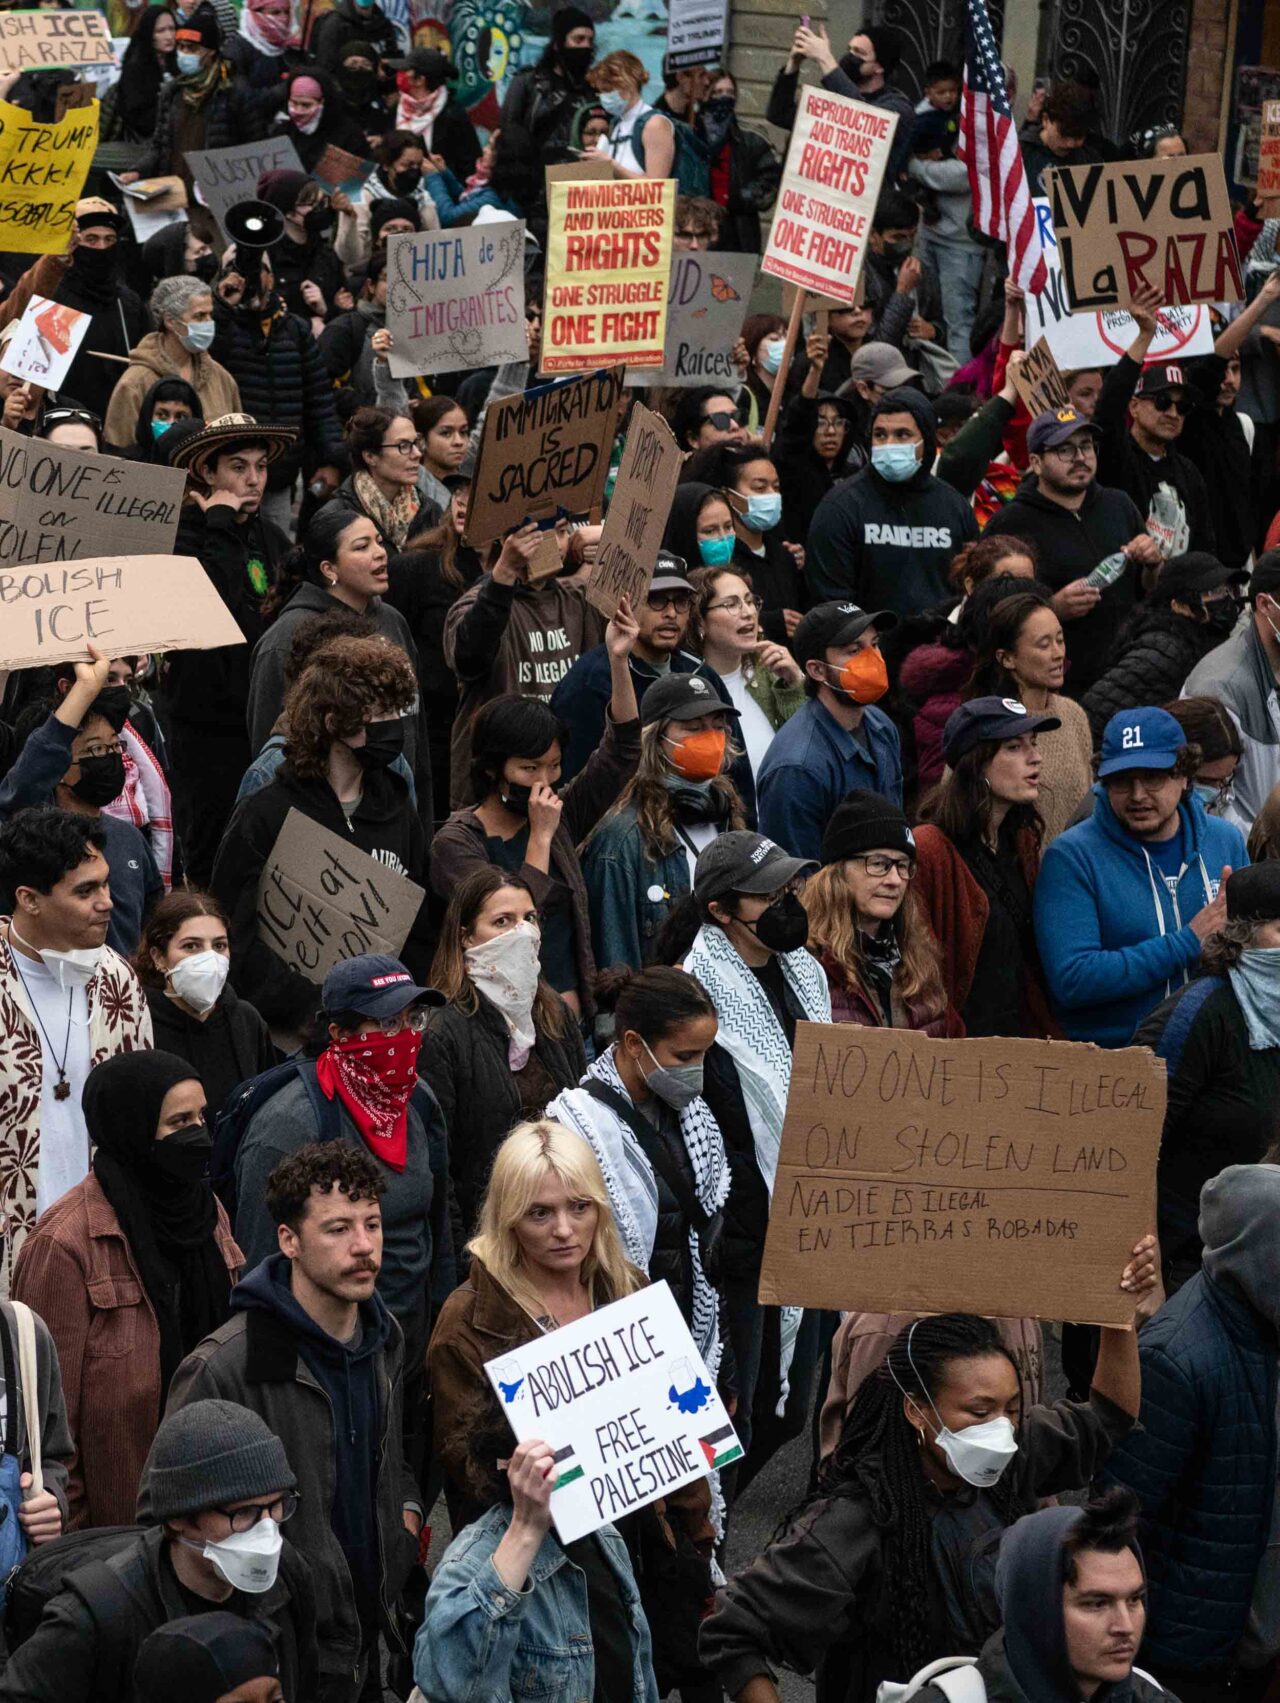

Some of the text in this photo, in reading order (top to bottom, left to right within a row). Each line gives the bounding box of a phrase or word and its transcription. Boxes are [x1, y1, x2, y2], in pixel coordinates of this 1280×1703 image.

[45, 14, 104, 38] ICE
[6, 47, 31, 70] LA
[39, 40, 114, 64] RAZA
[806, 95, 890, 140] REPRODUCTIVE
[810, 121, 873, 158] AND TRANS
[1, 159, 74, 186] KKK!
[203, 149, 288, 187] JUSTICE
[798, 144, 869, 197] RIGHTS
[567, 182, 663, 209] IMMIGRANT
[782, 190, 865, 237] ONE STRUGGLE
[564, 208, 664, 232] AND WORKERS
[412, 236, 494, 281] HIJA de
[565, 231, 660, 272] RIGHTS
[774, 219, 858, 274] ONE FIGHT
[408, 286, 518, 338] IMIGRANTES
[552, 281, 664, 307] ONE STRUGGLE
[551, 315, 596, 346] ONE
[601, 310, 661, 343] FIGHT
[496, 368, 624, 441] IMMIGRATION
[1056, 410, 1077, 422] Cal
[541, 427, 564, 455] IS
[29, 457, 101, 501] ONE
[103, 468, 121, 484] IS
[488, 443, 599, 503] SACRED
[95, 490, 176, 526] ILLEGAL
[864, 523, 952, 549] RAIDERS
[34, 599, 115, 646] ICE
[528, 627, 571, 653] NO ONE
[519, 661, 532, 683] IS
[1122, 725, 1144, 749] 21
[257, 849, 361, 949] ICE at
[812, 1042, 1155, 1117] NO ONE IS ILLEGAL
[805, 1123, 862, 1170] ON
[1052, 1143, 1128, 1174] LAND
[789, 1180, 990, 1218] NADIE ES ILEGAL
[799, 1217, 1079, 1253] EN TIERRAS ROBADAS
[527, 1316, 664, 1417] ABOLISH ICE
[595, 1408, 655, 1464] FREE
[590, 1434, 699, 1520] PALESTINE
